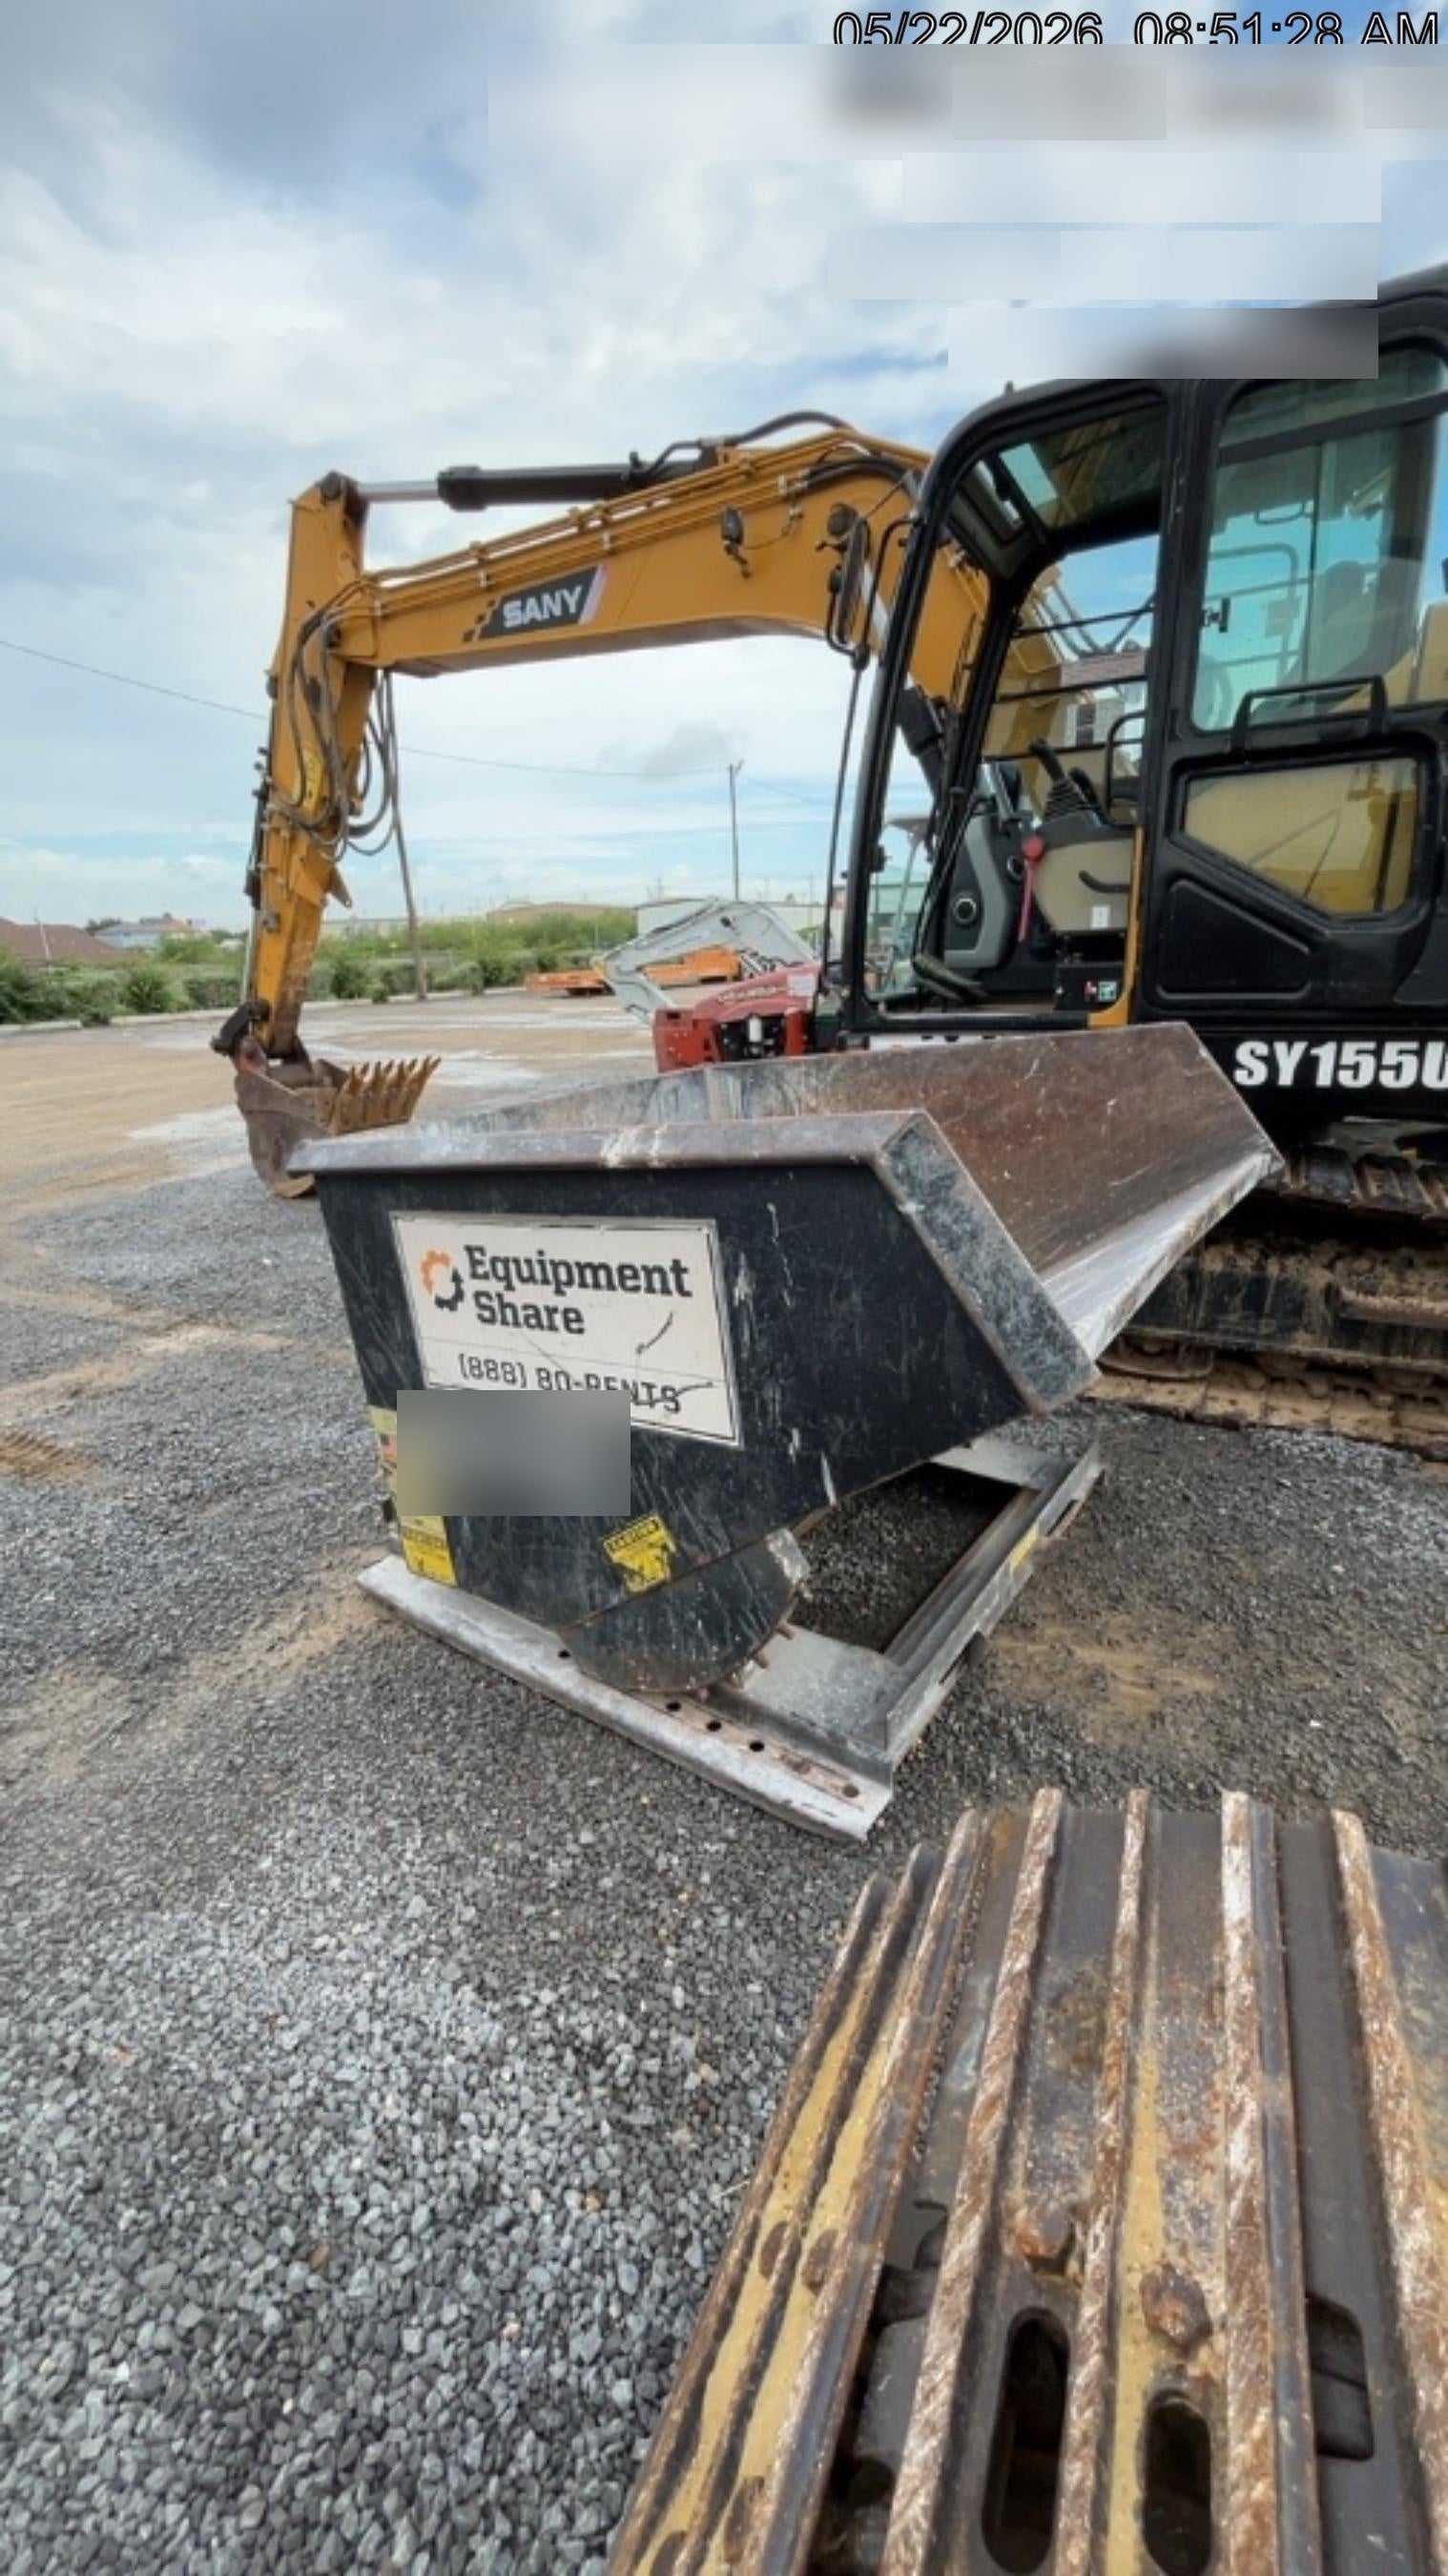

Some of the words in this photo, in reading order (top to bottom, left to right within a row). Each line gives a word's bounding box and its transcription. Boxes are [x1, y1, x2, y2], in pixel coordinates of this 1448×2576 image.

[503, 586, 583, 629] SANY
[1233, 1041, 1448, 1089] SY155U
[464, 1244, 693, 1298] Equipment
[473, 1290, 585, 1335] Share
[459, 1353, 527, 1388] (888)
